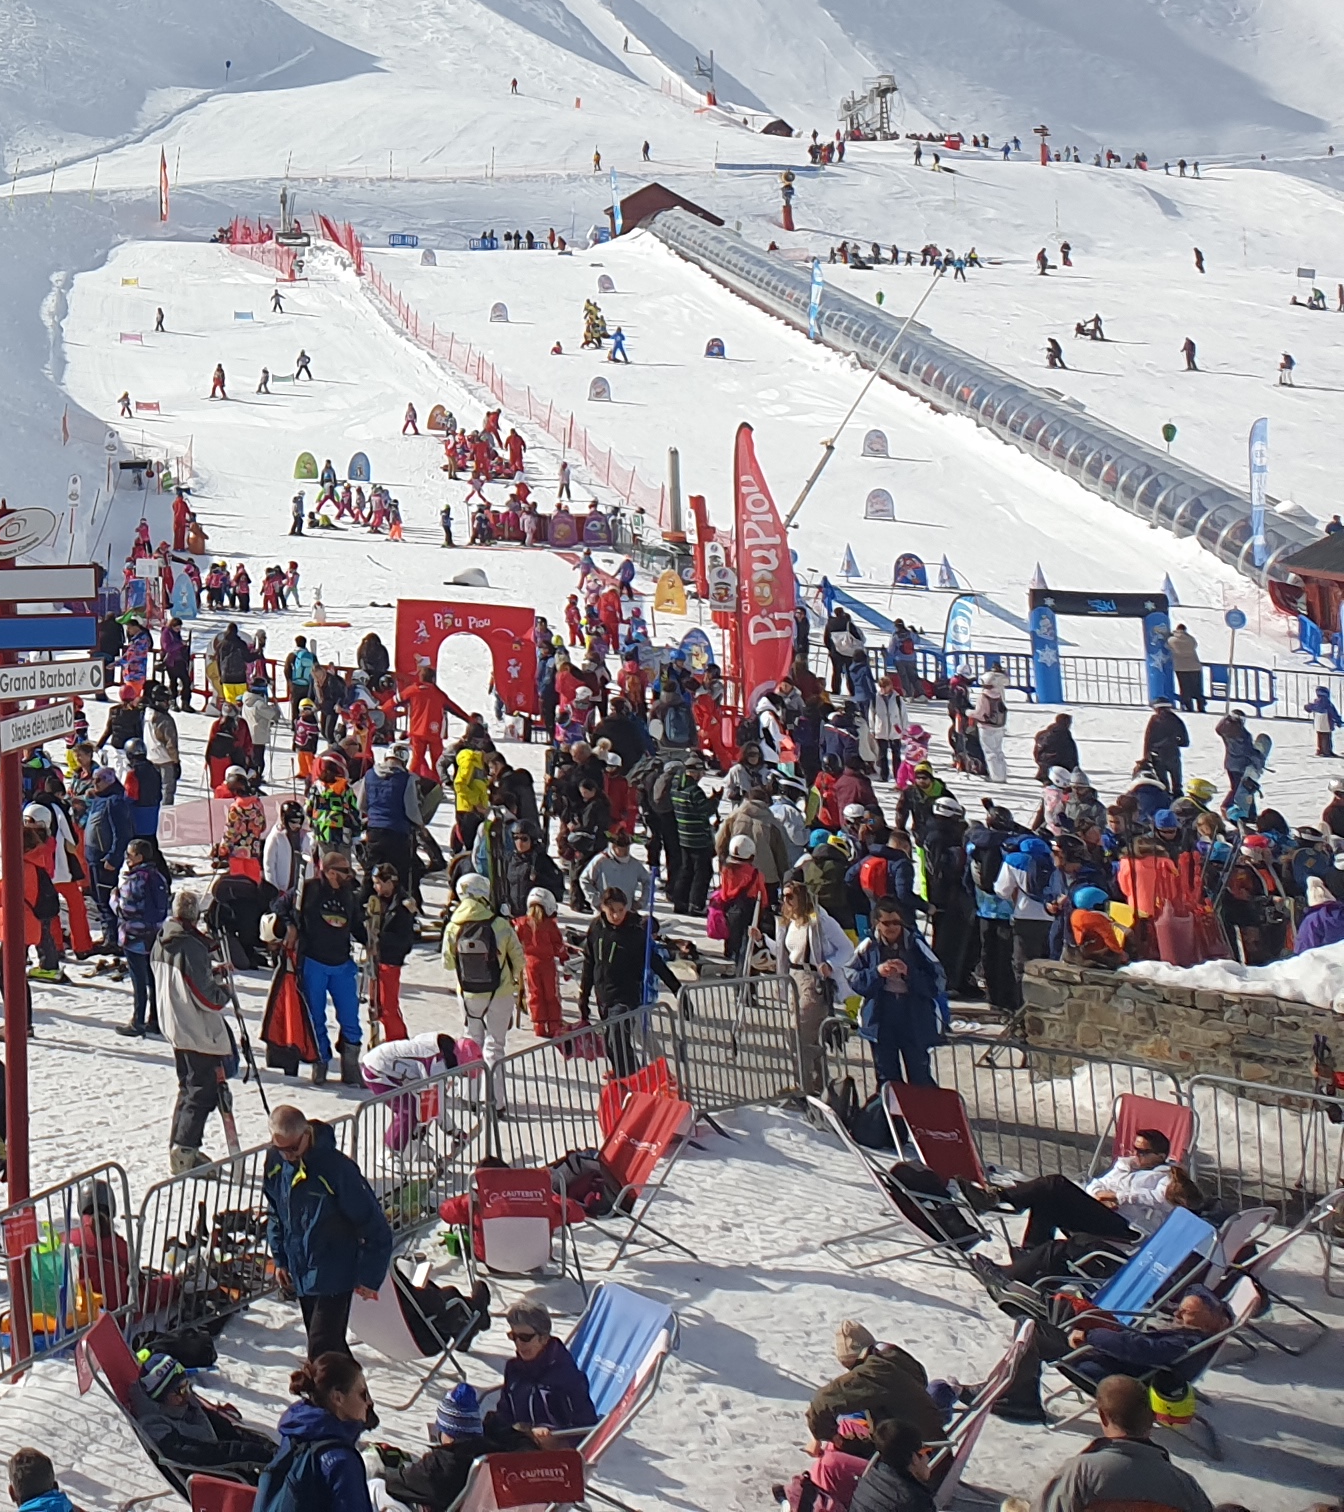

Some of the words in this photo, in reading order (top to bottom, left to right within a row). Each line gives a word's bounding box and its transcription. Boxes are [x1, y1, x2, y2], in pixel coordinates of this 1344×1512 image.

[467, 615, 491, 630] Piou
[0, 670, 36, 693] Grand
[39, 667, 77, 689] Barbat
[11, 722, 31, 743] Stade
